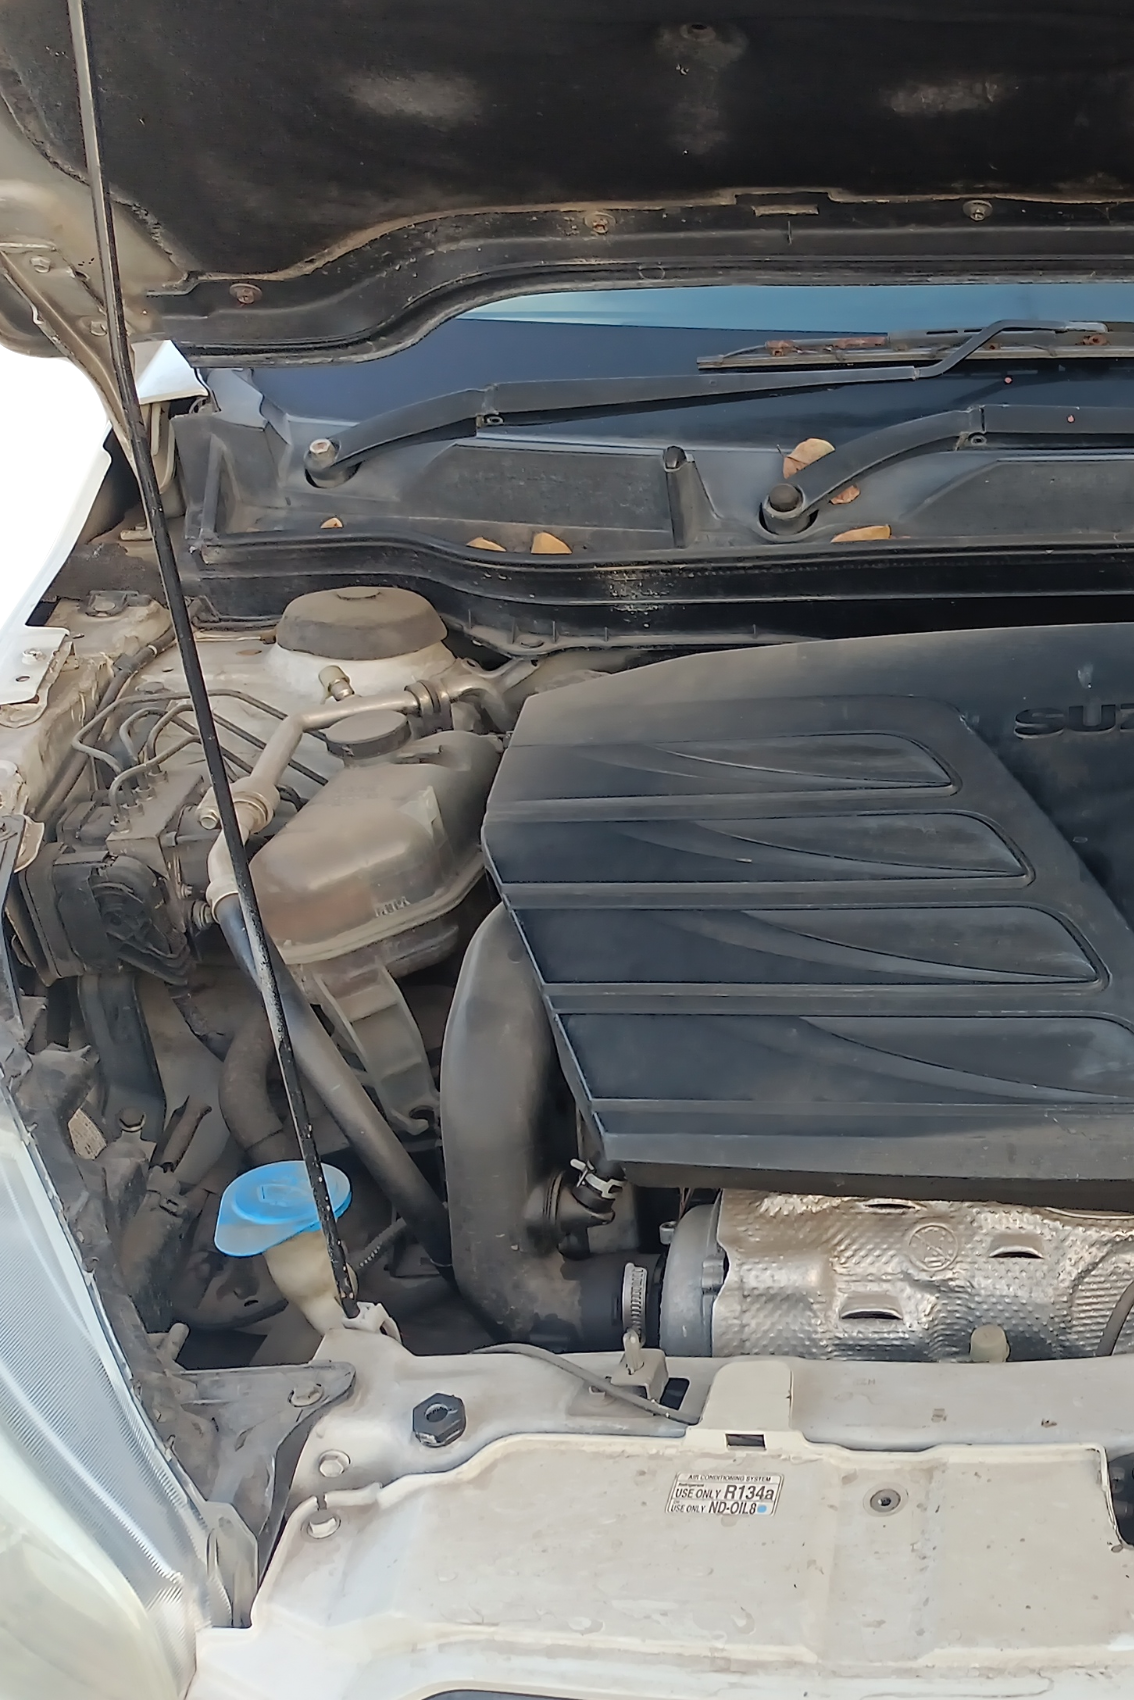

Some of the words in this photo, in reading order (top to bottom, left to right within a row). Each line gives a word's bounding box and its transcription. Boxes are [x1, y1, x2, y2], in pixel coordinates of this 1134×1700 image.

[675, 1488, 694, 1499] USE
[695, 1488, 722, 1499] ONLY
[724, 1484, 775, 1500] R134a
[671, 1504, 685, 1513] USE
[686, 1504, 706, 1513] ONLY
[708, 1501, 757, 1515] ND-OIL8
